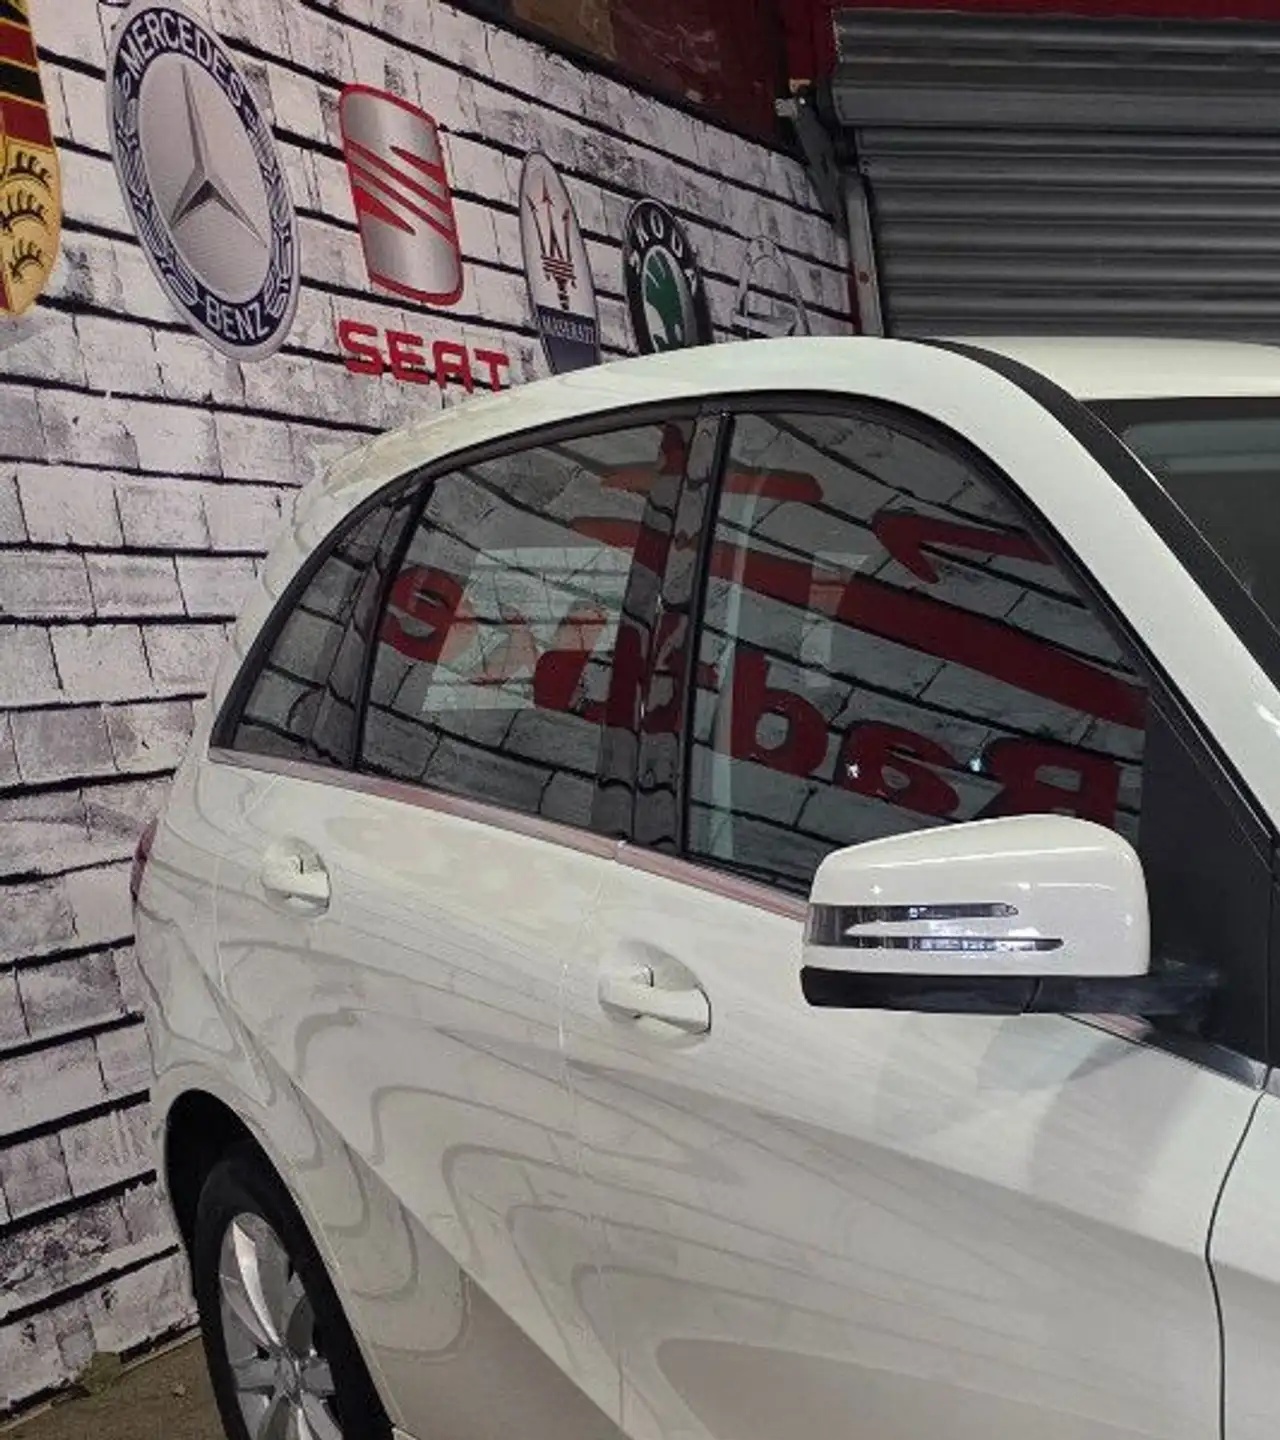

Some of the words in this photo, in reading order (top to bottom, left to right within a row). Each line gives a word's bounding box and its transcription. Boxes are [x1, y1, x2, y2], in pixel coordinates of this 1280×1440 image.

[120, 12, 244, 108] MERCEDES
[206, 298, 271, 342] BENZ
[338, 319, 510, 394] SEAT
